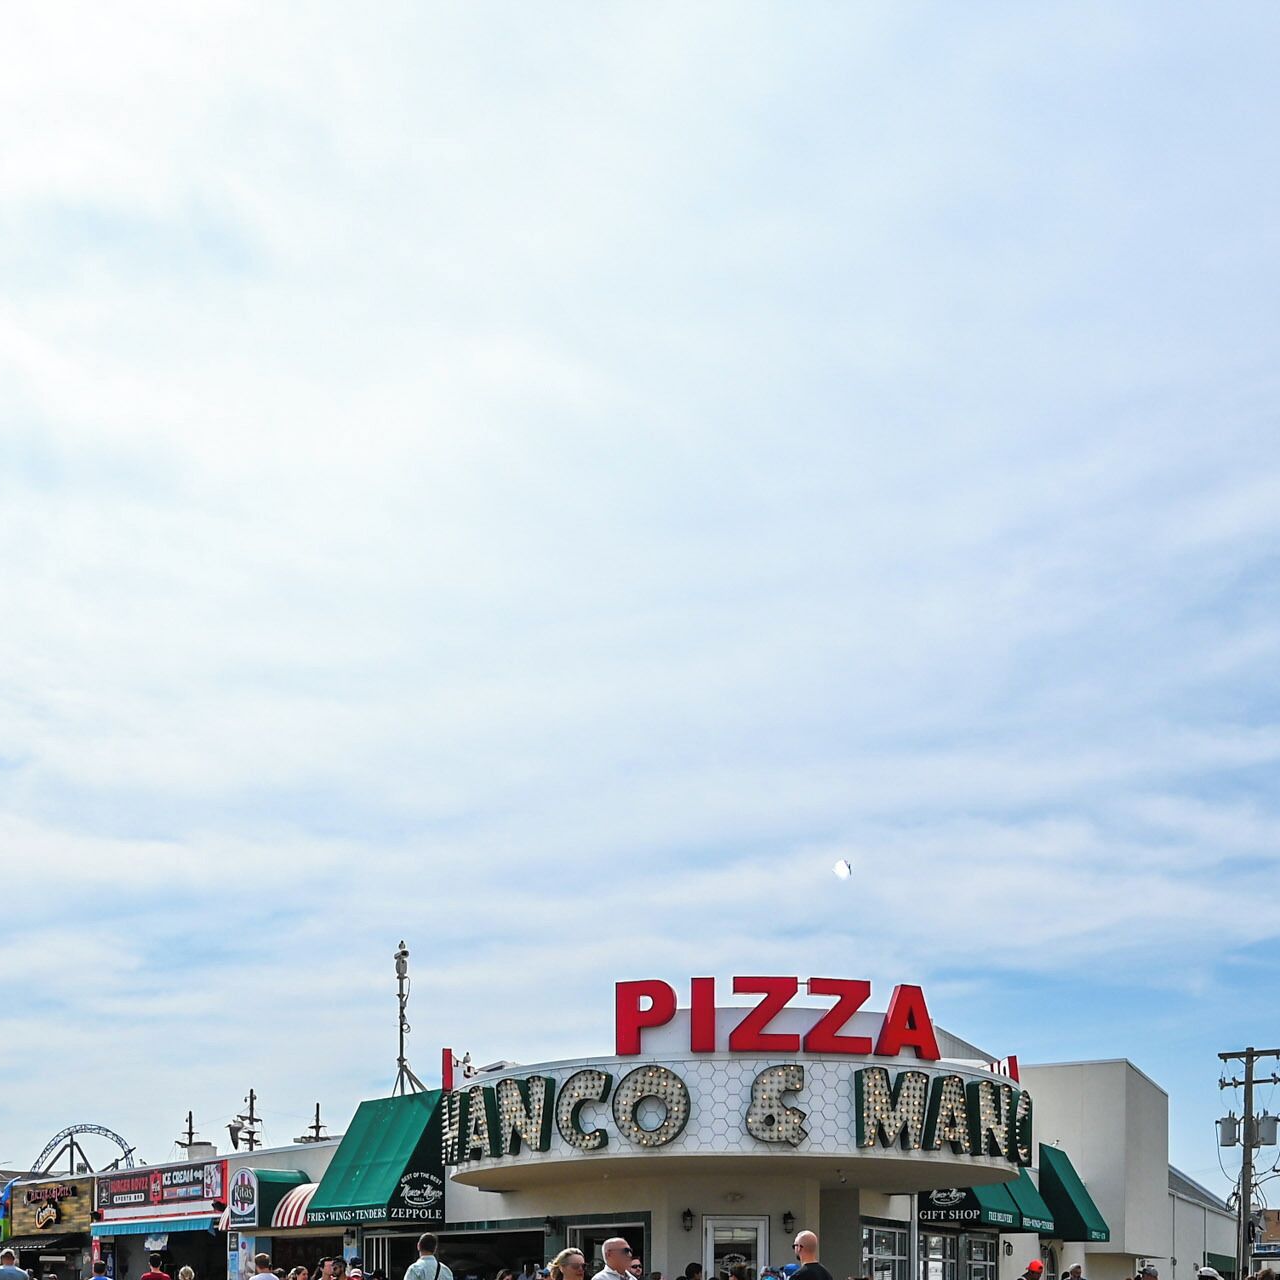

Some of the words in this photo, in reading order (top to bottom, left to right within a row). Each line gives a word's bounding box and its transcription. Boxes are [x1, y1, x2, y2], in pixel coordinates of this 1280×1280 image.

[615, 976, 941, 1061] PIZZA
[745, 1064, 808, 1147] &
[162, 1173, 172, 1186] ICE
[173, 1169, 194, 1185] CREAM
[401, 1173, 412, 1183] BEST
[430, 1175, 442, 1185] BEST
[235, 1184, 253, 1199] Rita's
[307, 1212, 326, 1222] FRIES
[330, 1210, 352, 1221] WINGS
[356, 1208, 386, 1220] TENDERS
[391, 1208, 442, 1219] ZEPPOLE
[920, 1210, 947, 1220] GIFT
[949, 1209, 980, 1219] SHOP
